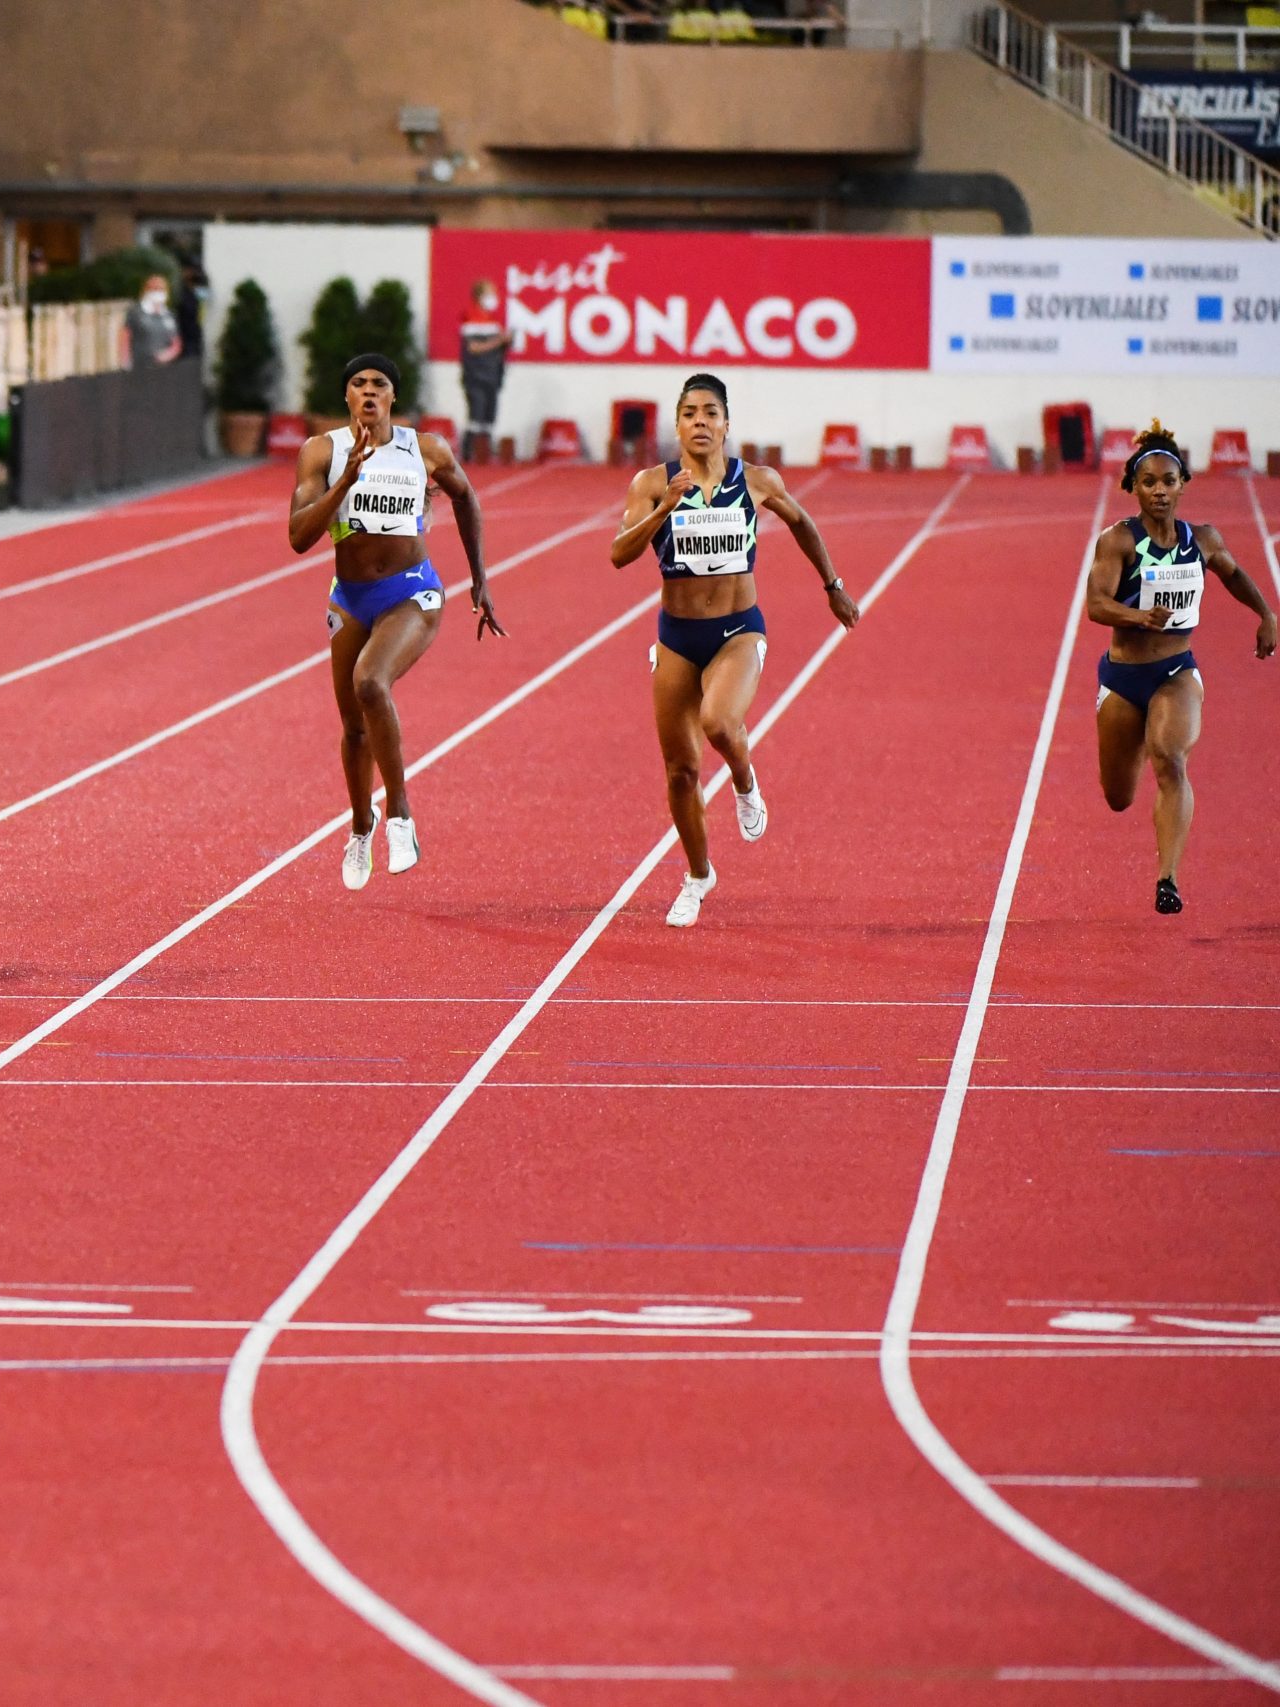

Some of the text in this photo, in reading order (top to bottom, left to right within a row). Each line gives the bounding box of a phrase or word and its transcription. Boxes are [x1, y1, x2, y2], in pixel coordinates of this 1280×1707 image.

[506, 243, 626, 295] visit
[1024, 294, 1170, 322] SLOVENIJALES
[506, 294, 858, 360] MONACO
[353, 493, 416, 516] OKAGBARE
[676, 534, 744, 556] KAMBUNDJI
[1153, 590, 1196, 610] BRYANT
